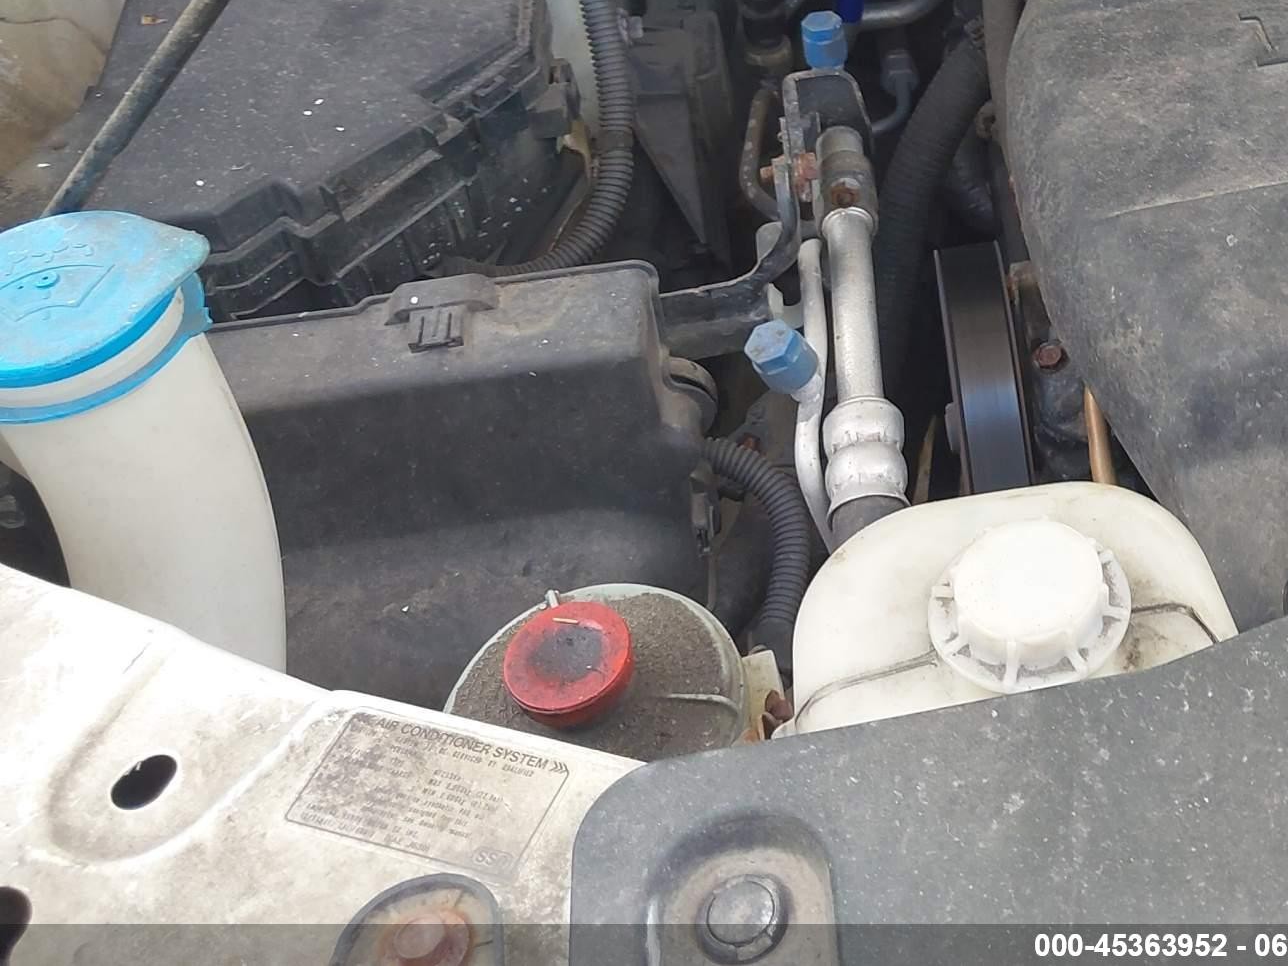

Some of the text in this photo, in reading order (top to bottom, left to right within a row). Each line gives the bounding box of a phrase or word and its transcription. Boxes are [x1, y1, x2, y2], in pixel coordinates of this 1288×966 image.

[376, 717, 398, 733] AIR
[400, 725, 490, 756] CONDITIONER
[492, 747, 549, 770] SYSTEM
